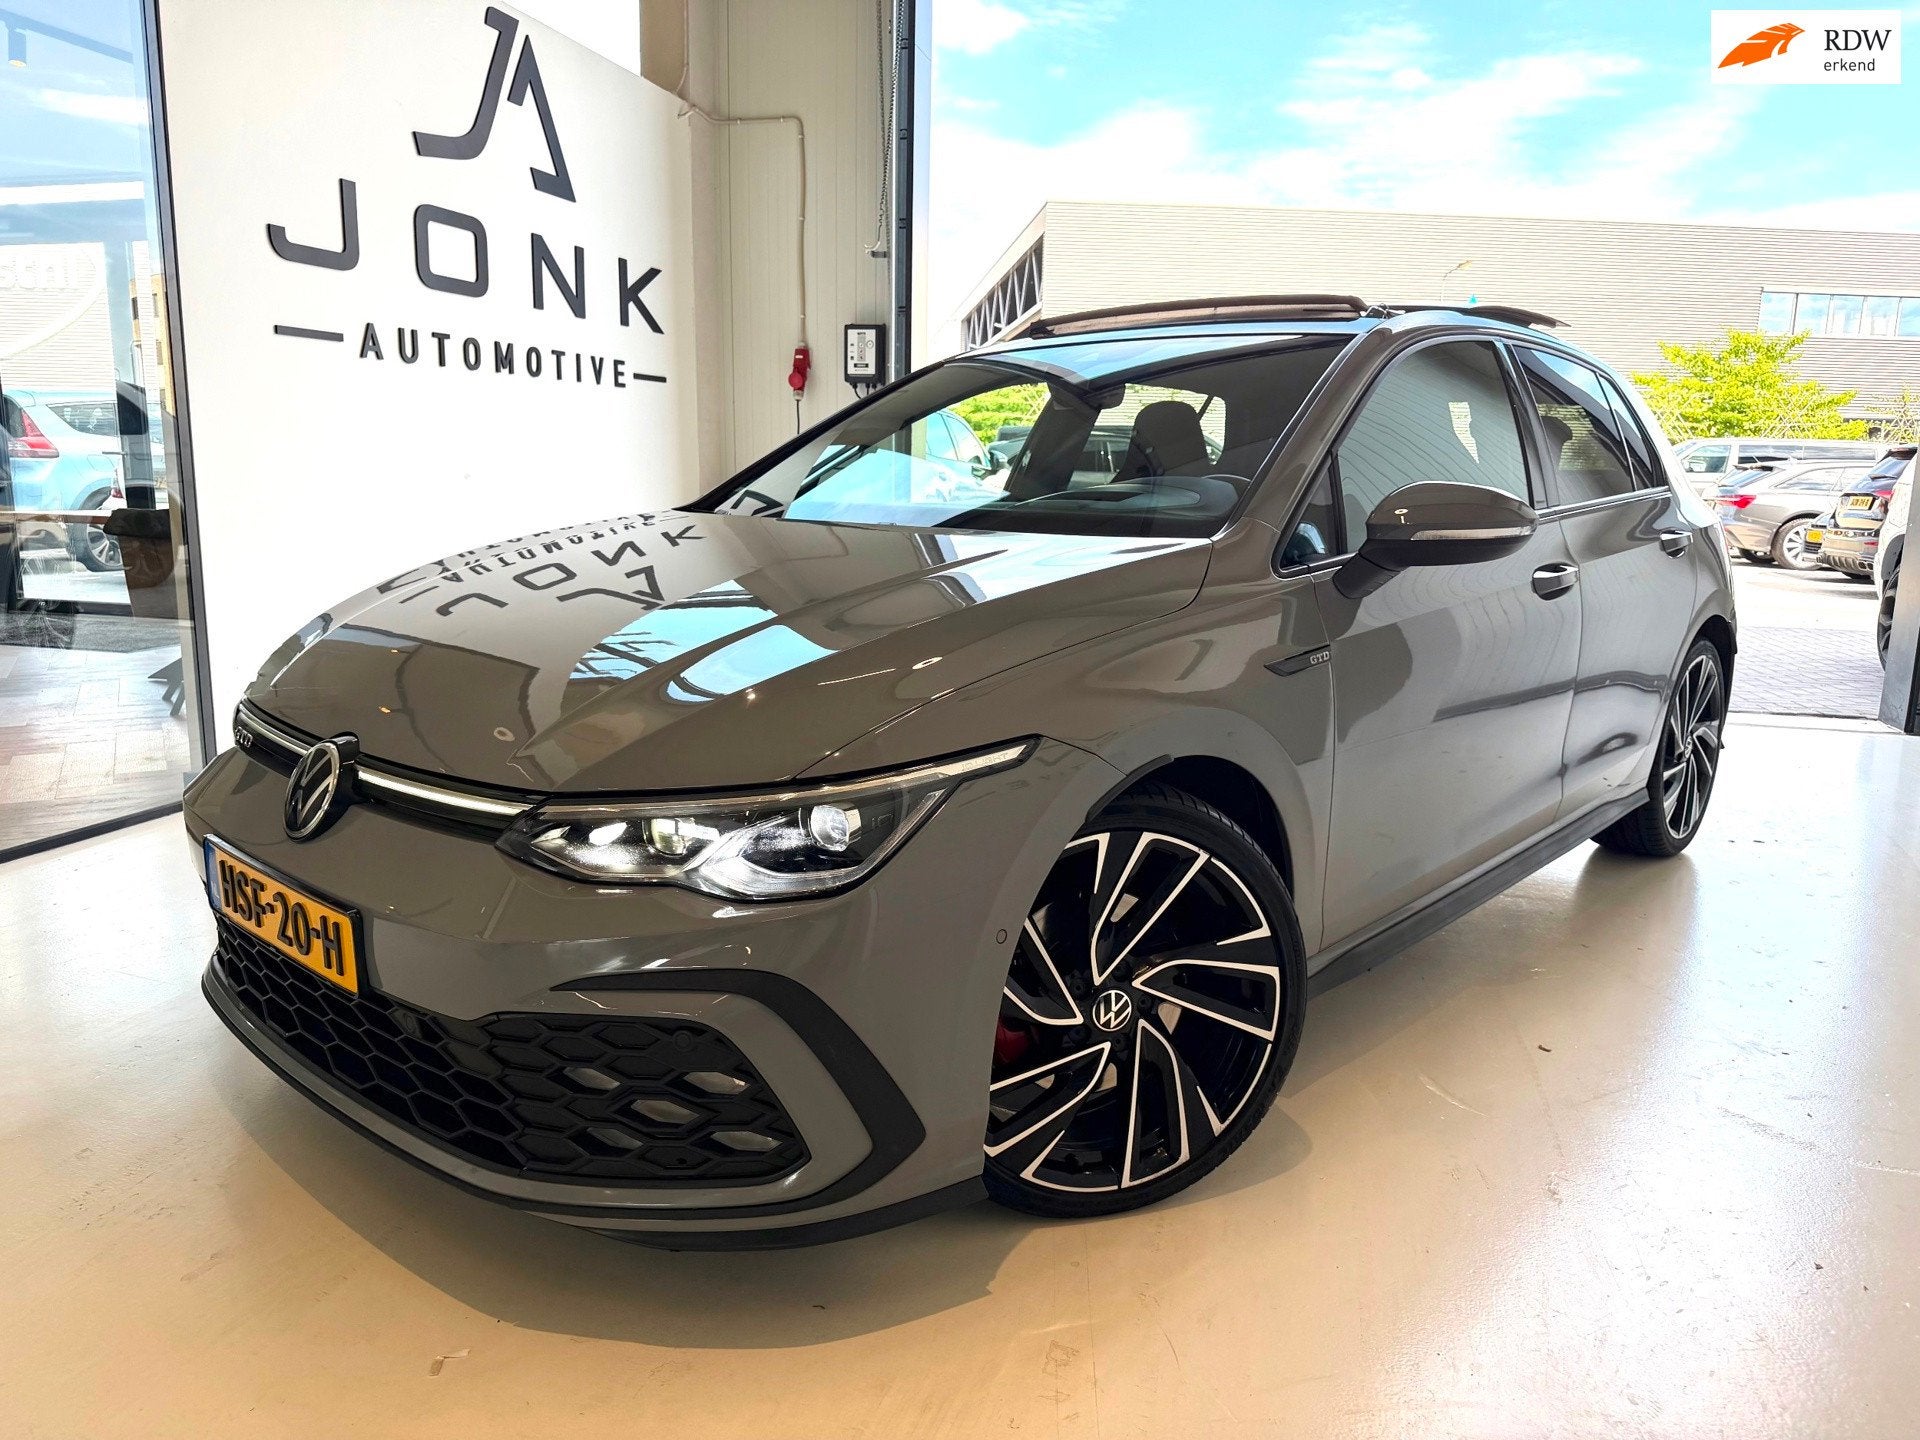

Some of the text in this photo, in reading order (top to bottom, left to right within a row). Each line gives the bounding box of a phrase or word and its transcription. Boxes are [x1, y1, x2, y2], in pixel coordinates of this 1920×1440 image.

[267, 178, 665, 335] JONK
[359, 322, 626, 388] AUTOMOTIVE
[1309, 651, 1330, 665] GTD
[219, 860, 344, 976] HSF-20-H
